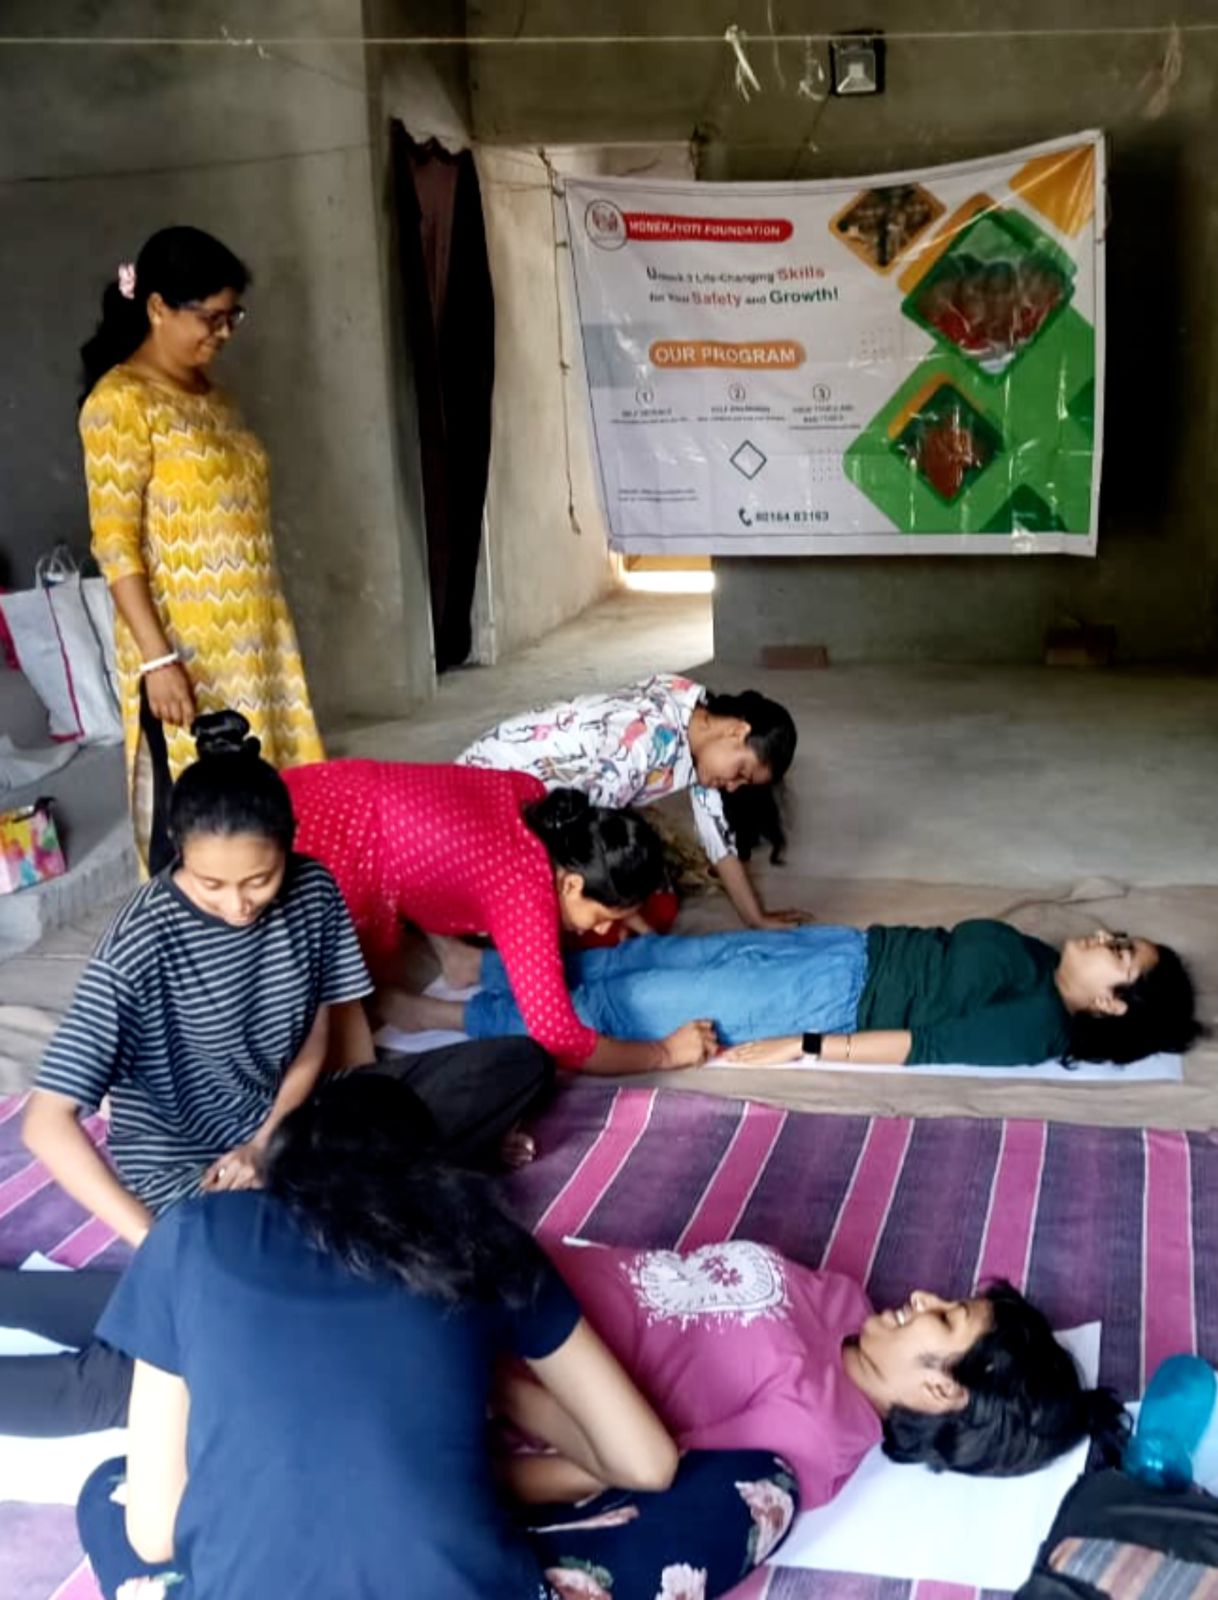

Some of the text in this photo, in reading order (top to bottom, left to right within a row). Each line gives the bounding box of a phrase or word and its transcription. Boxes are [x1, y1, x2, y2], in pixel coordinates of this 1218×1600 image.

[704, 223, 780, 237] FOUNDATION
[695, 271, 775, 285] Life-Changing
[776, 265, 826, 282] Skills
[691, 290, 742, 309] Safety
[745, 293, 767, 305] and
[769, 286, 839, 305] Growth!
[655, 346, 797, 364] OUR PROGRAM
